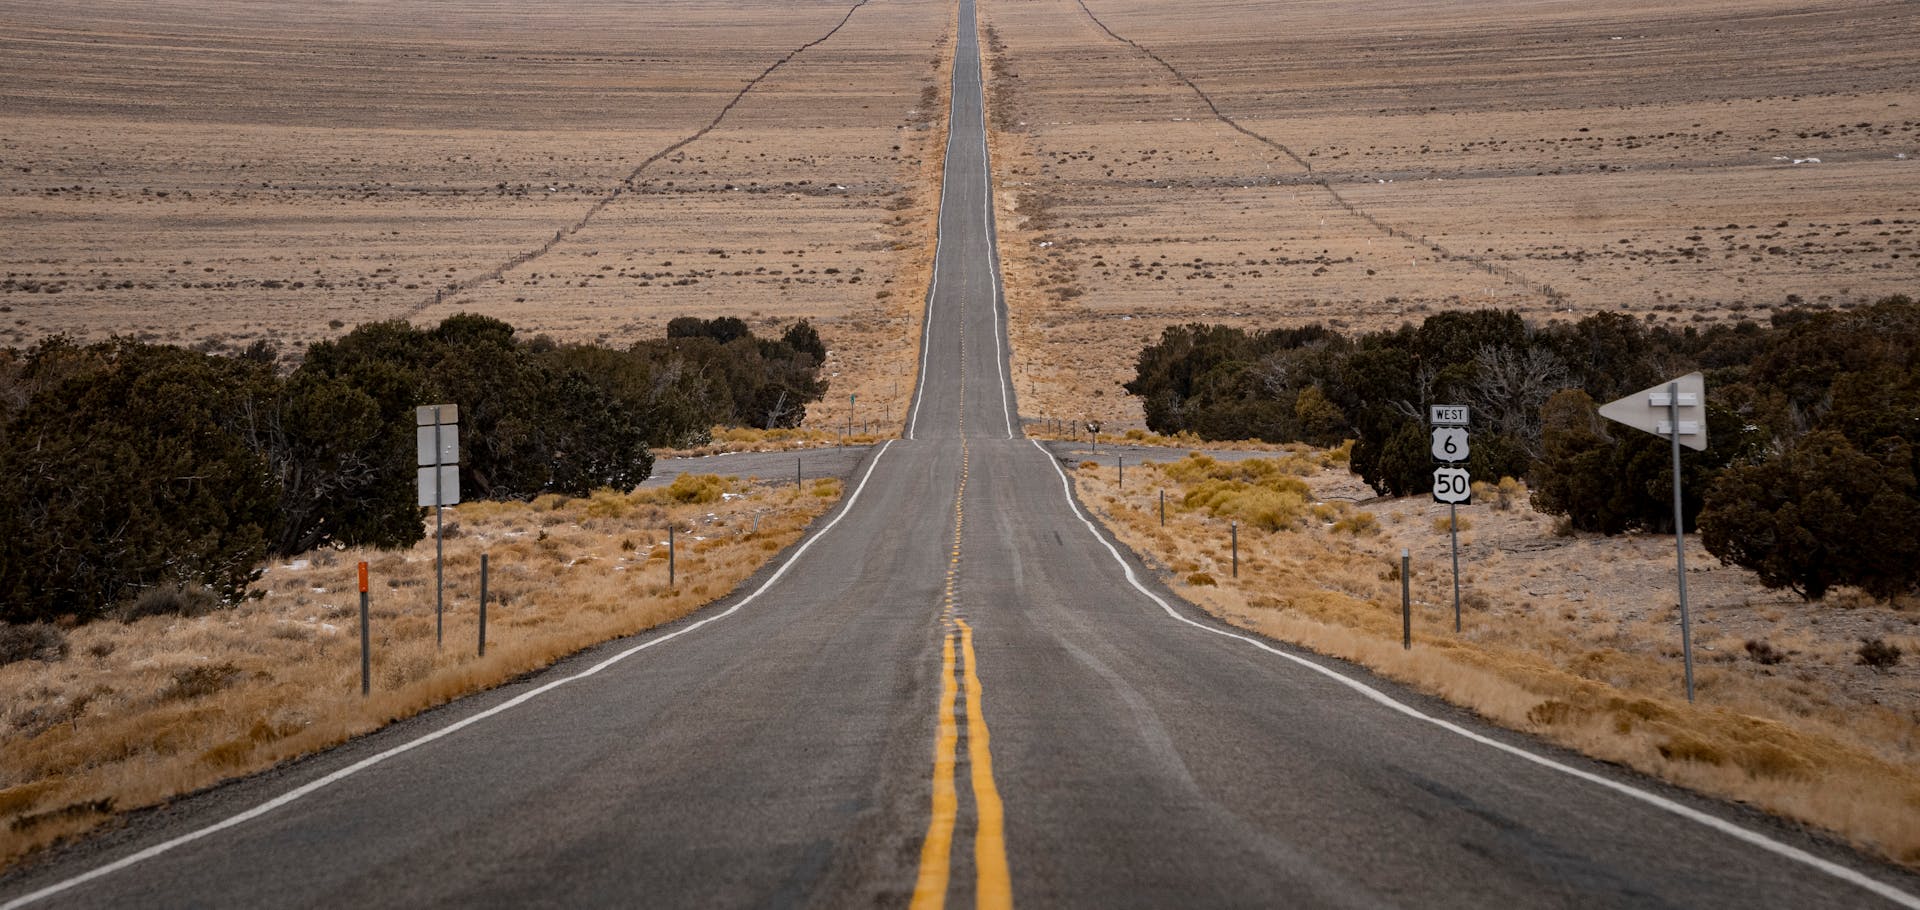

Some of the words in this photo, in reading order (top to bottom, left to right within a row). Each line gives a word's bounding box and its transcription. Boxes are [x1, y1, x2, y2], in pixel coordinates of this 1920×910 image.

[1436, 410, 1463, 420] WEST
[1444, 435, 1457, 454] 6
[1438, 474, 1466, 494] 50
